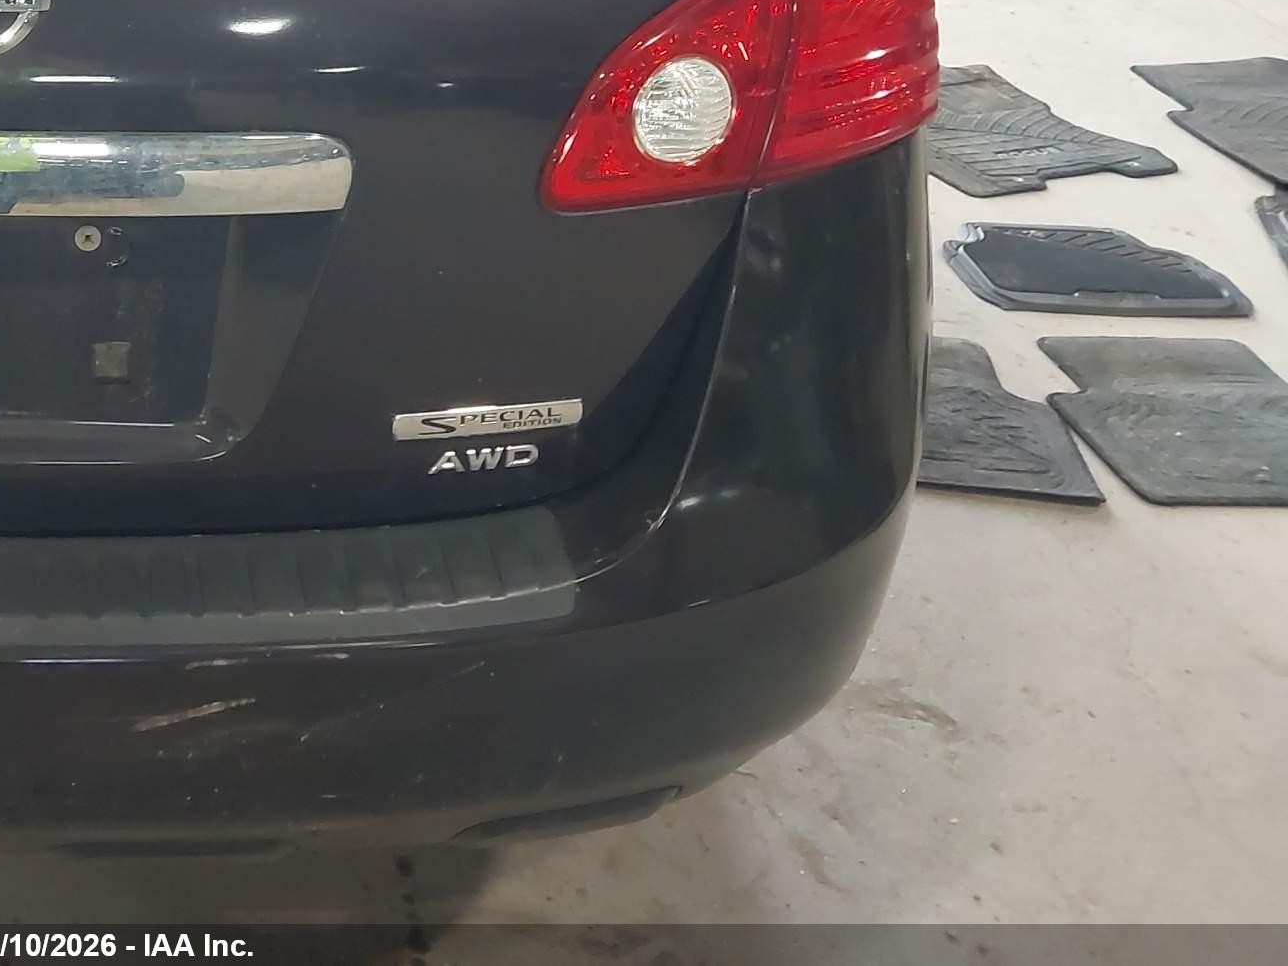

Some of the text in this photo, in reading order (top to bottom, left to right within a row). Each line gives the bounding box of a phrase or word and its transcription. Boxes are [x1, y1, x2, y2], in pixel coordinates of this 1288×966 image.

[417, 407, 562, 436] SPECIAL
[502, 417, 563, 430] EDITION
[427, 443, 539, 475] AWD
